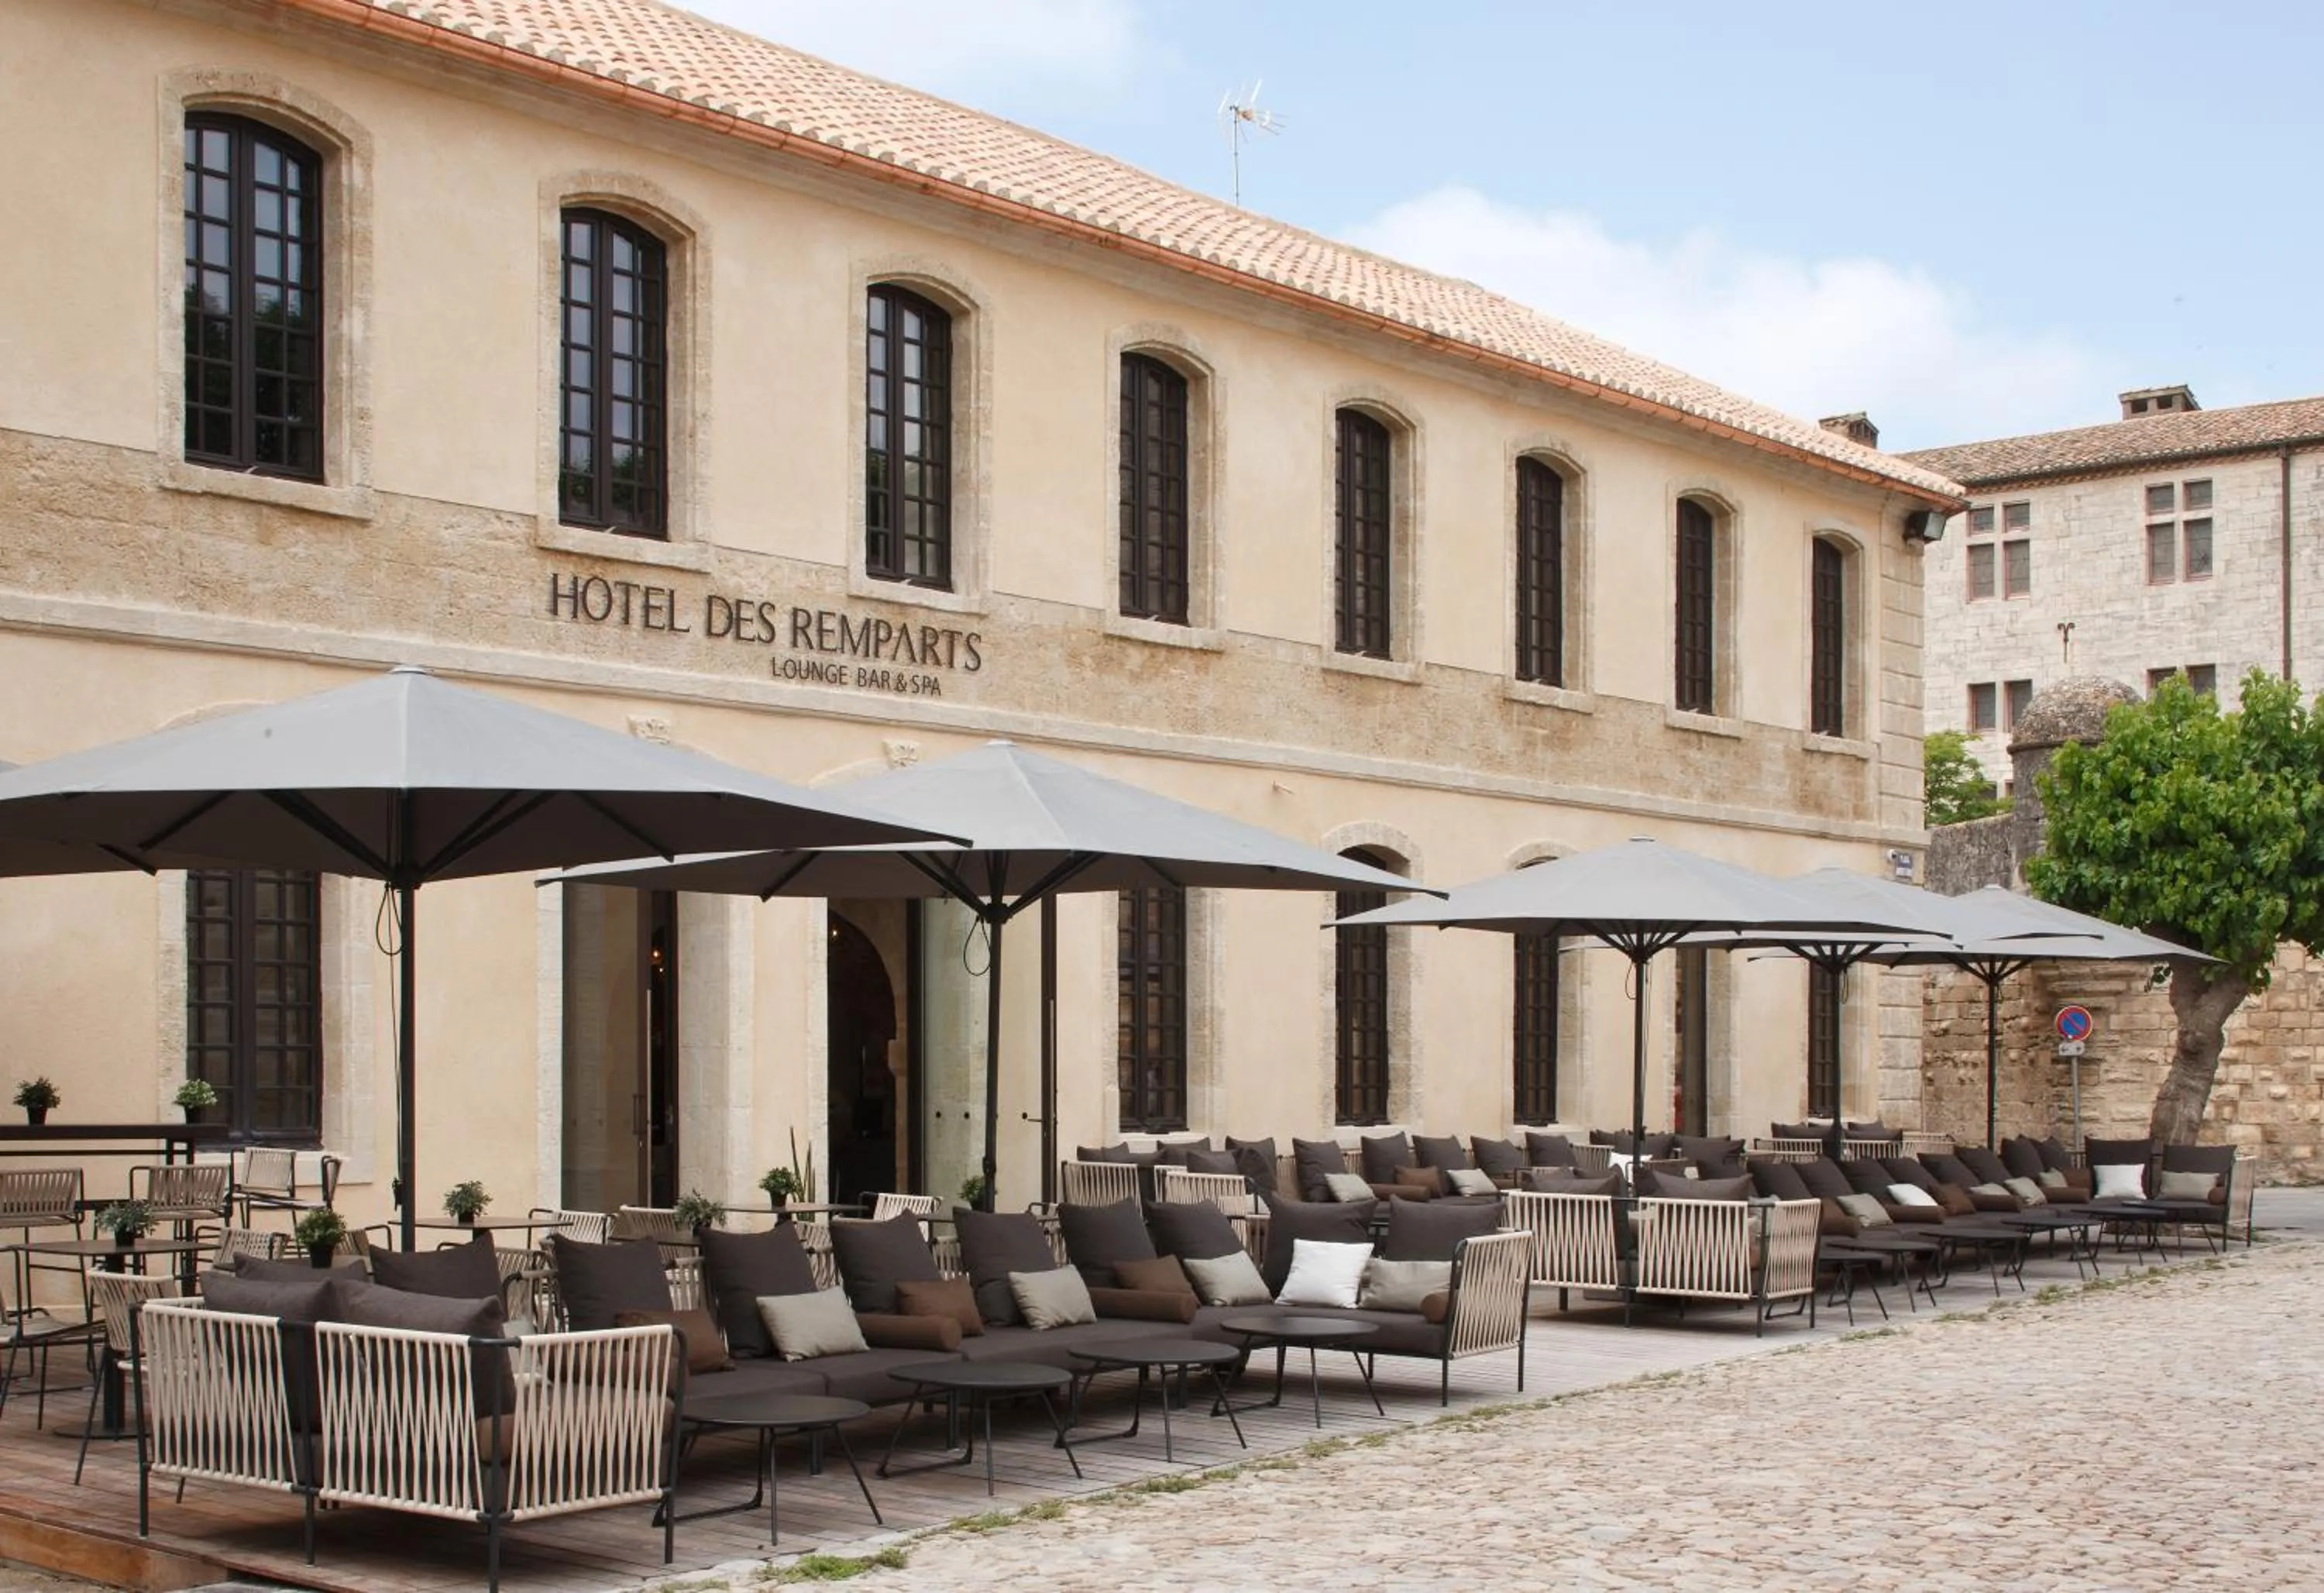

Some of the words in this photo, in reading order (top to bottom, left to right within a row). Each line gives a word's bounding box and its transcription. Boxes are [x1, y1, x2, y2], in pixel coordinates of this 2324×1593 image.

[551, 573, 690, 633] HOTEL
[706, 594, 777, 644] DES
[790, 607, 982, 672] REMPARTS
[772, 657, 847, 686] LOUNGE
